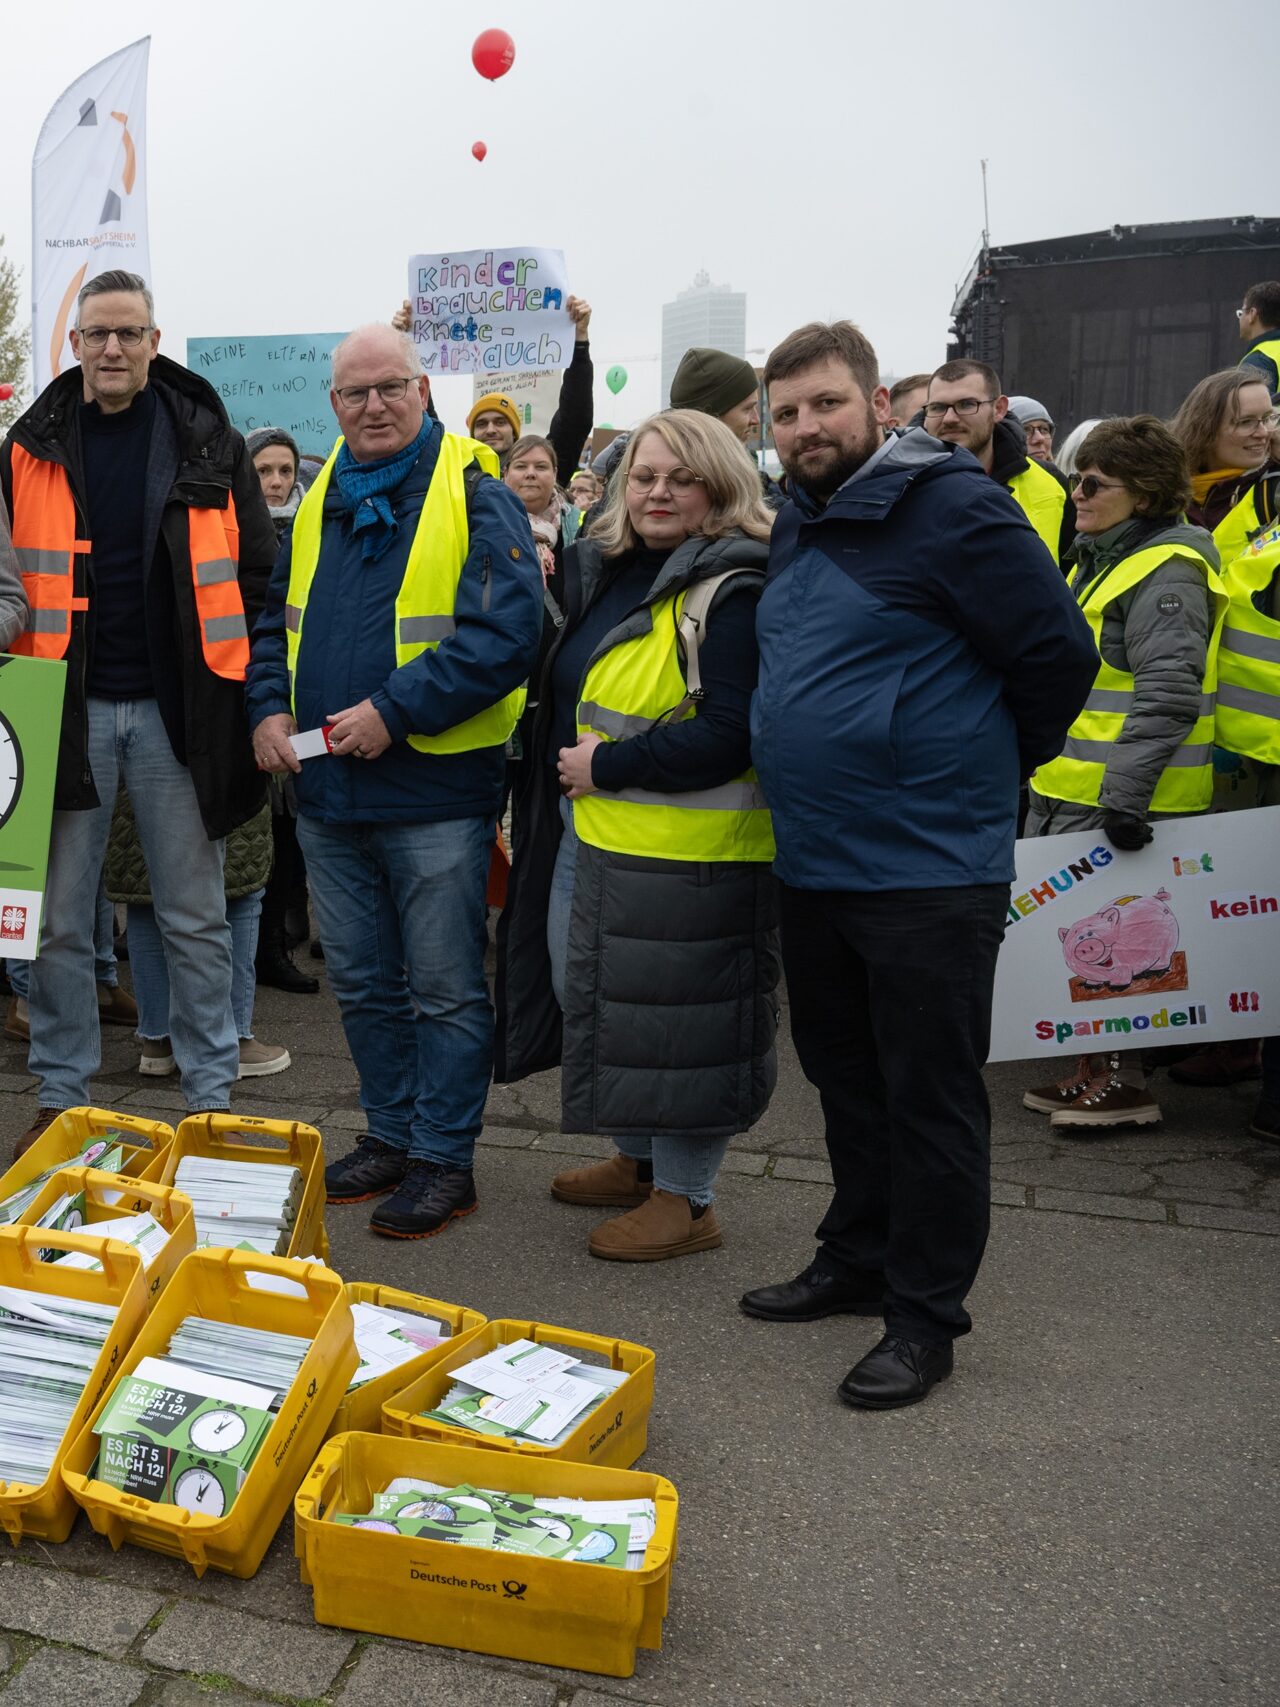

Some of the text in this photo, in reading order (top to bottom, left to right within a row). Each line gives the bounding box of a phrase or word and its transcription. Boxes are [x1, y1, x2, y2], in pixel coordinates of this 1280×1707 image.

[199, 343, 247, 367] MEINE
[268, 346, 316, 363] ELTERN
[483, 333, 562, 368] auch
[1172, 853, 1214, 877] ist
[1005, 846, 1114, 928] IEHUNG
[1210, 895, 1279, 919] kein
[1035, 1005, 1207, 1044] Sparmodell
[125, 1392, 187, 1416] NACH 12!
[130, 1383, 186, 1404] ES IST 5
[106, 1437, 159, 1462] ES IST 5
[105, 1451, 165, 1479] NACH 12!
[130, 1474, 144, 1482] NRW
[143, 1478, 157, 1486] muss
[380, 1495, 399, 1503] ES
[410, 1569, 498, 1593] Deutsche Post
